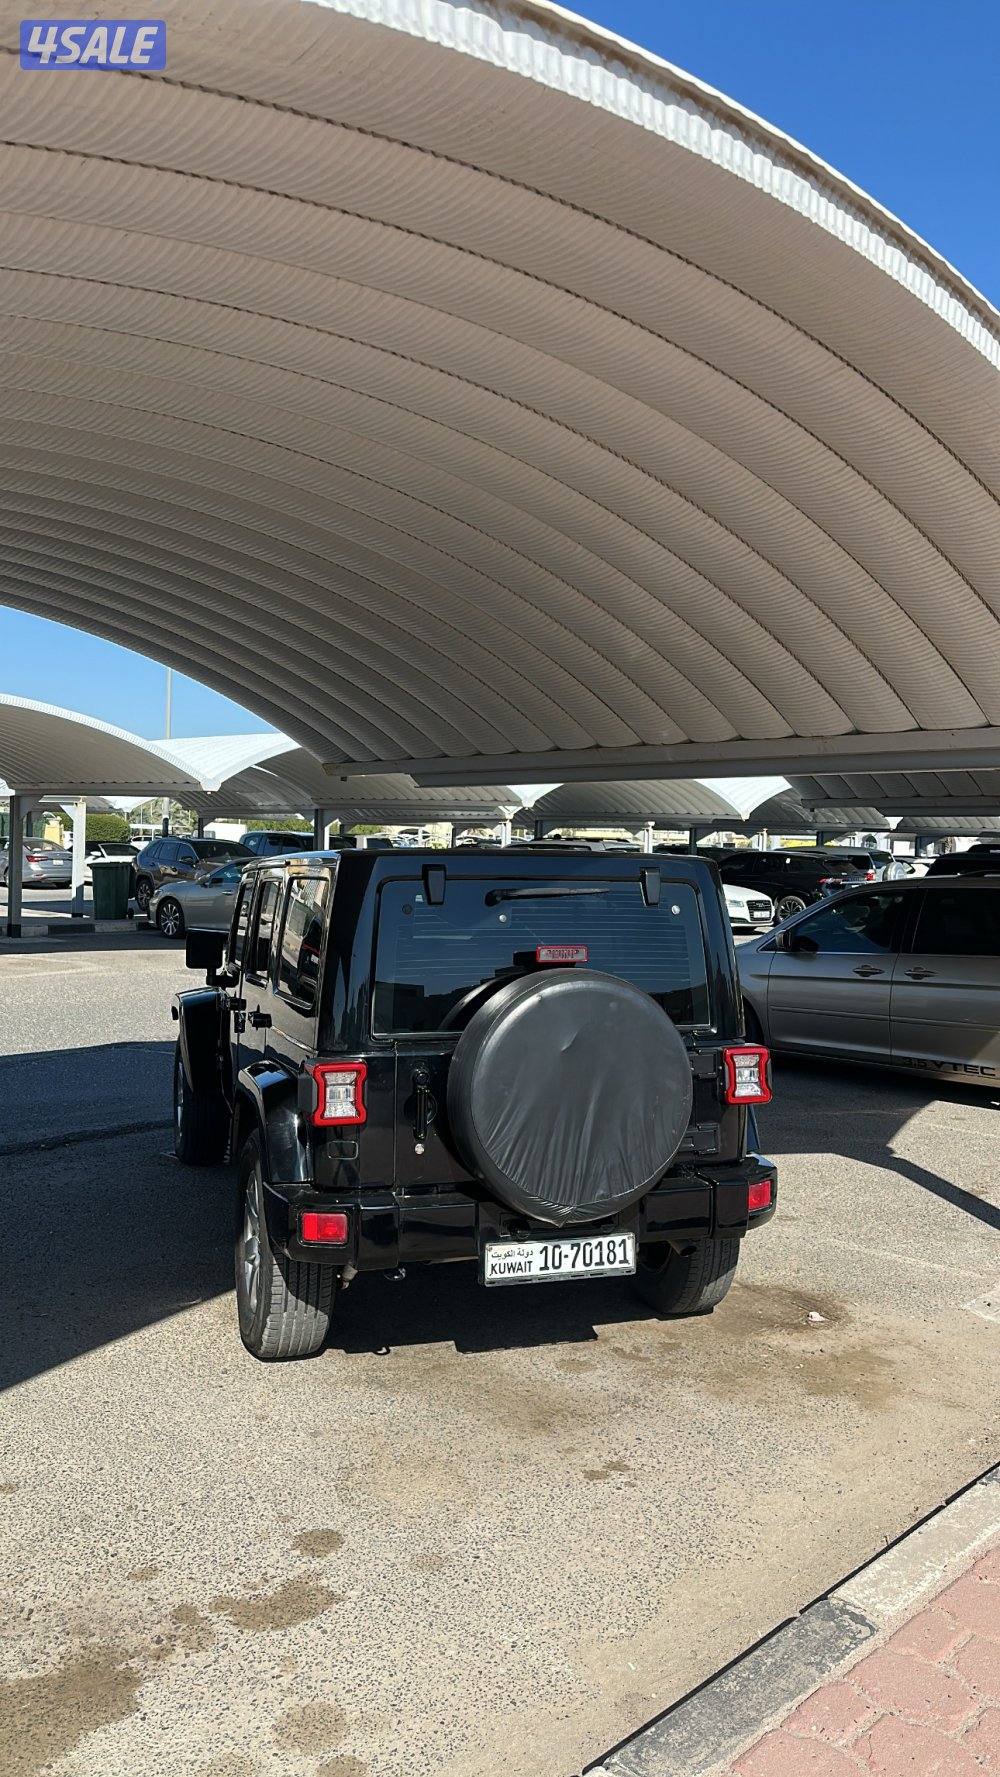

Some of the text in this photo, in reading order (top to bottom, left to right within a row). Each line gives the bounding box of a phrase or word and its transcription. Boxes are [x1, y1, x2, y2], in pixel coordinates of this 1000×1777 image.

[930, 1060, 996, 1077] VTEC
[491, 1247, 534, 1261] دولة الكويت
[539, 1238, 630, 1272] 10-70181
[490, 1260, 533, 1276] KUWAIT
